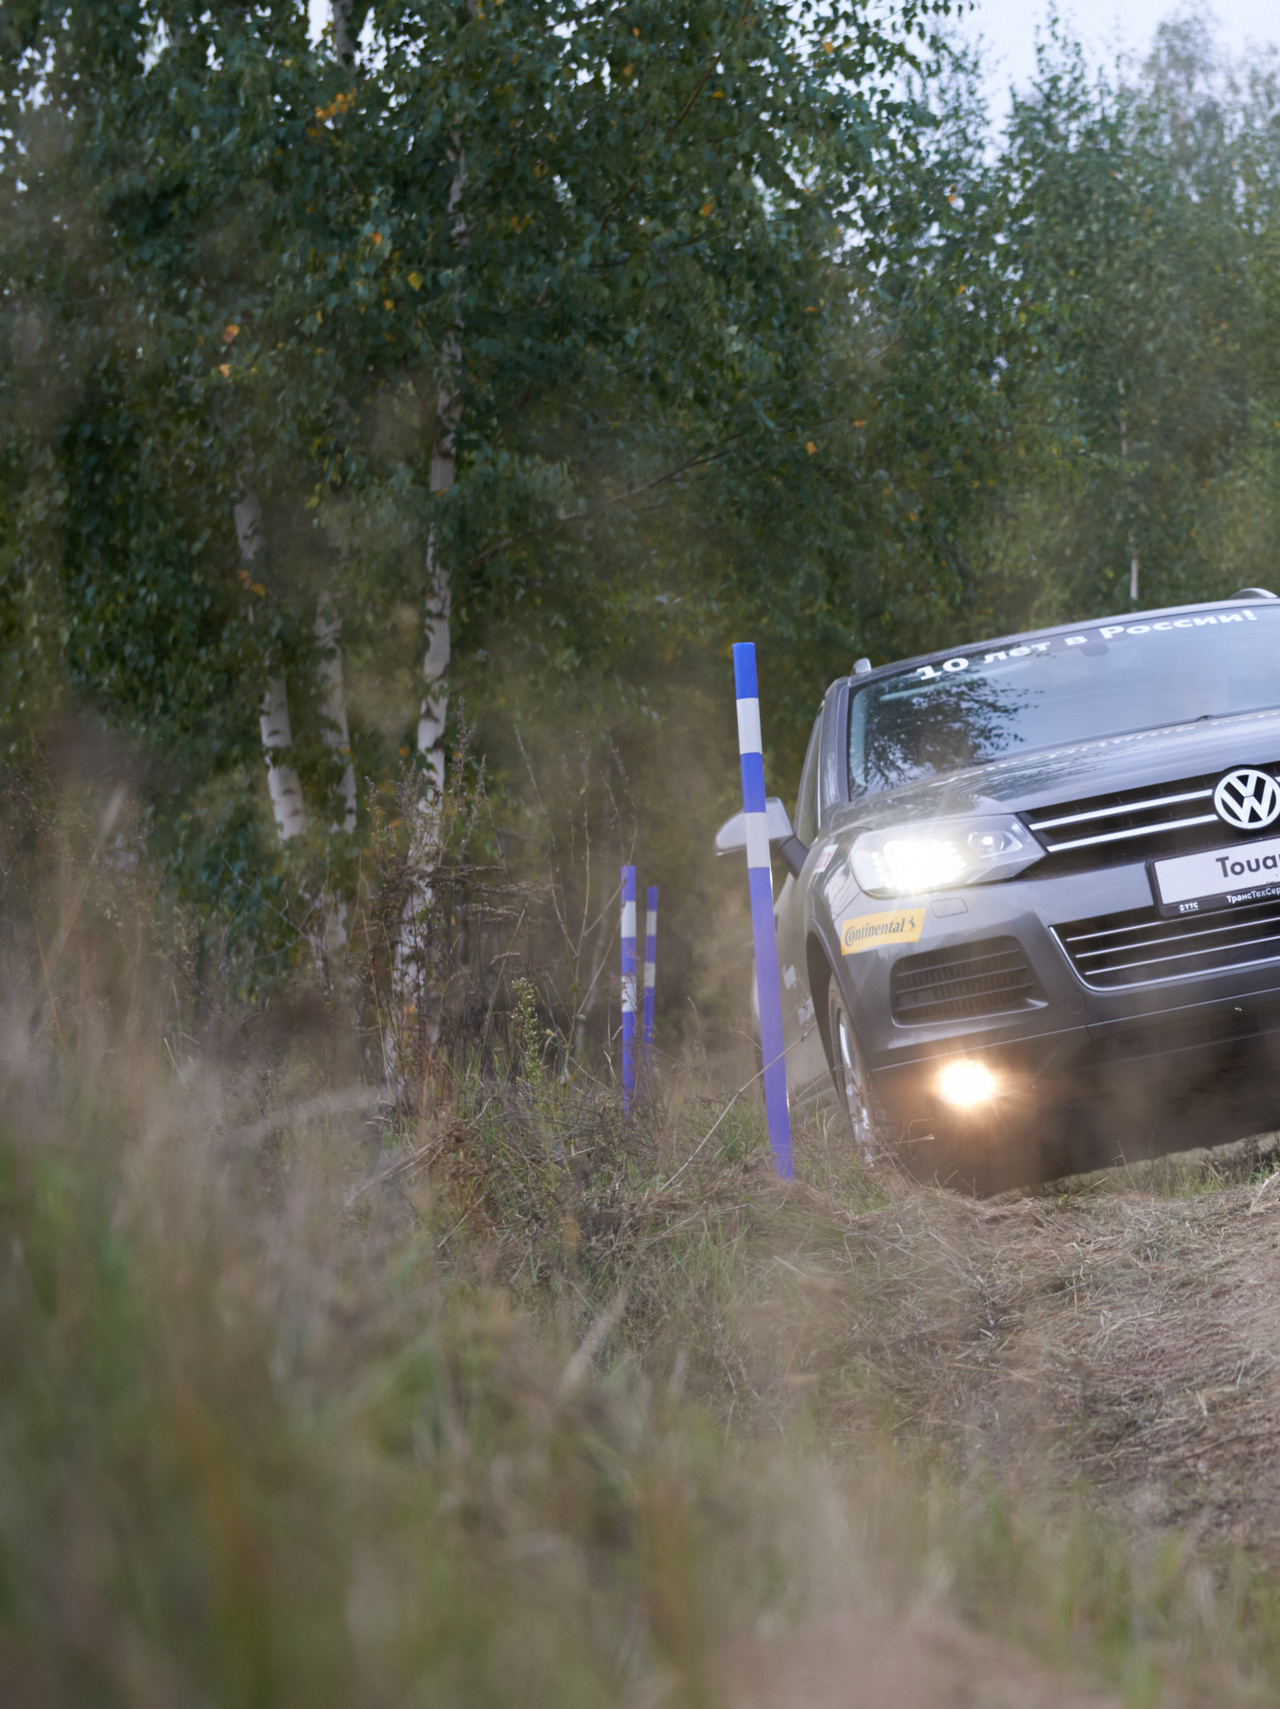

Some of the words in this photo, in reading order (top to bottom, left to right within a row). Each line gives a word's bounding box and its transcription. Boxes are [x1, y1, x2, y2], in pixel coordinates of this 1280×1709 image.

[917, 658, 969, 681] 10
[984, 642, 1051, 664] лет
[1064, 635, 1088, 646] в
[1099, 609, 1258, 639] России!
[844, 918, 906, 947] Continental
